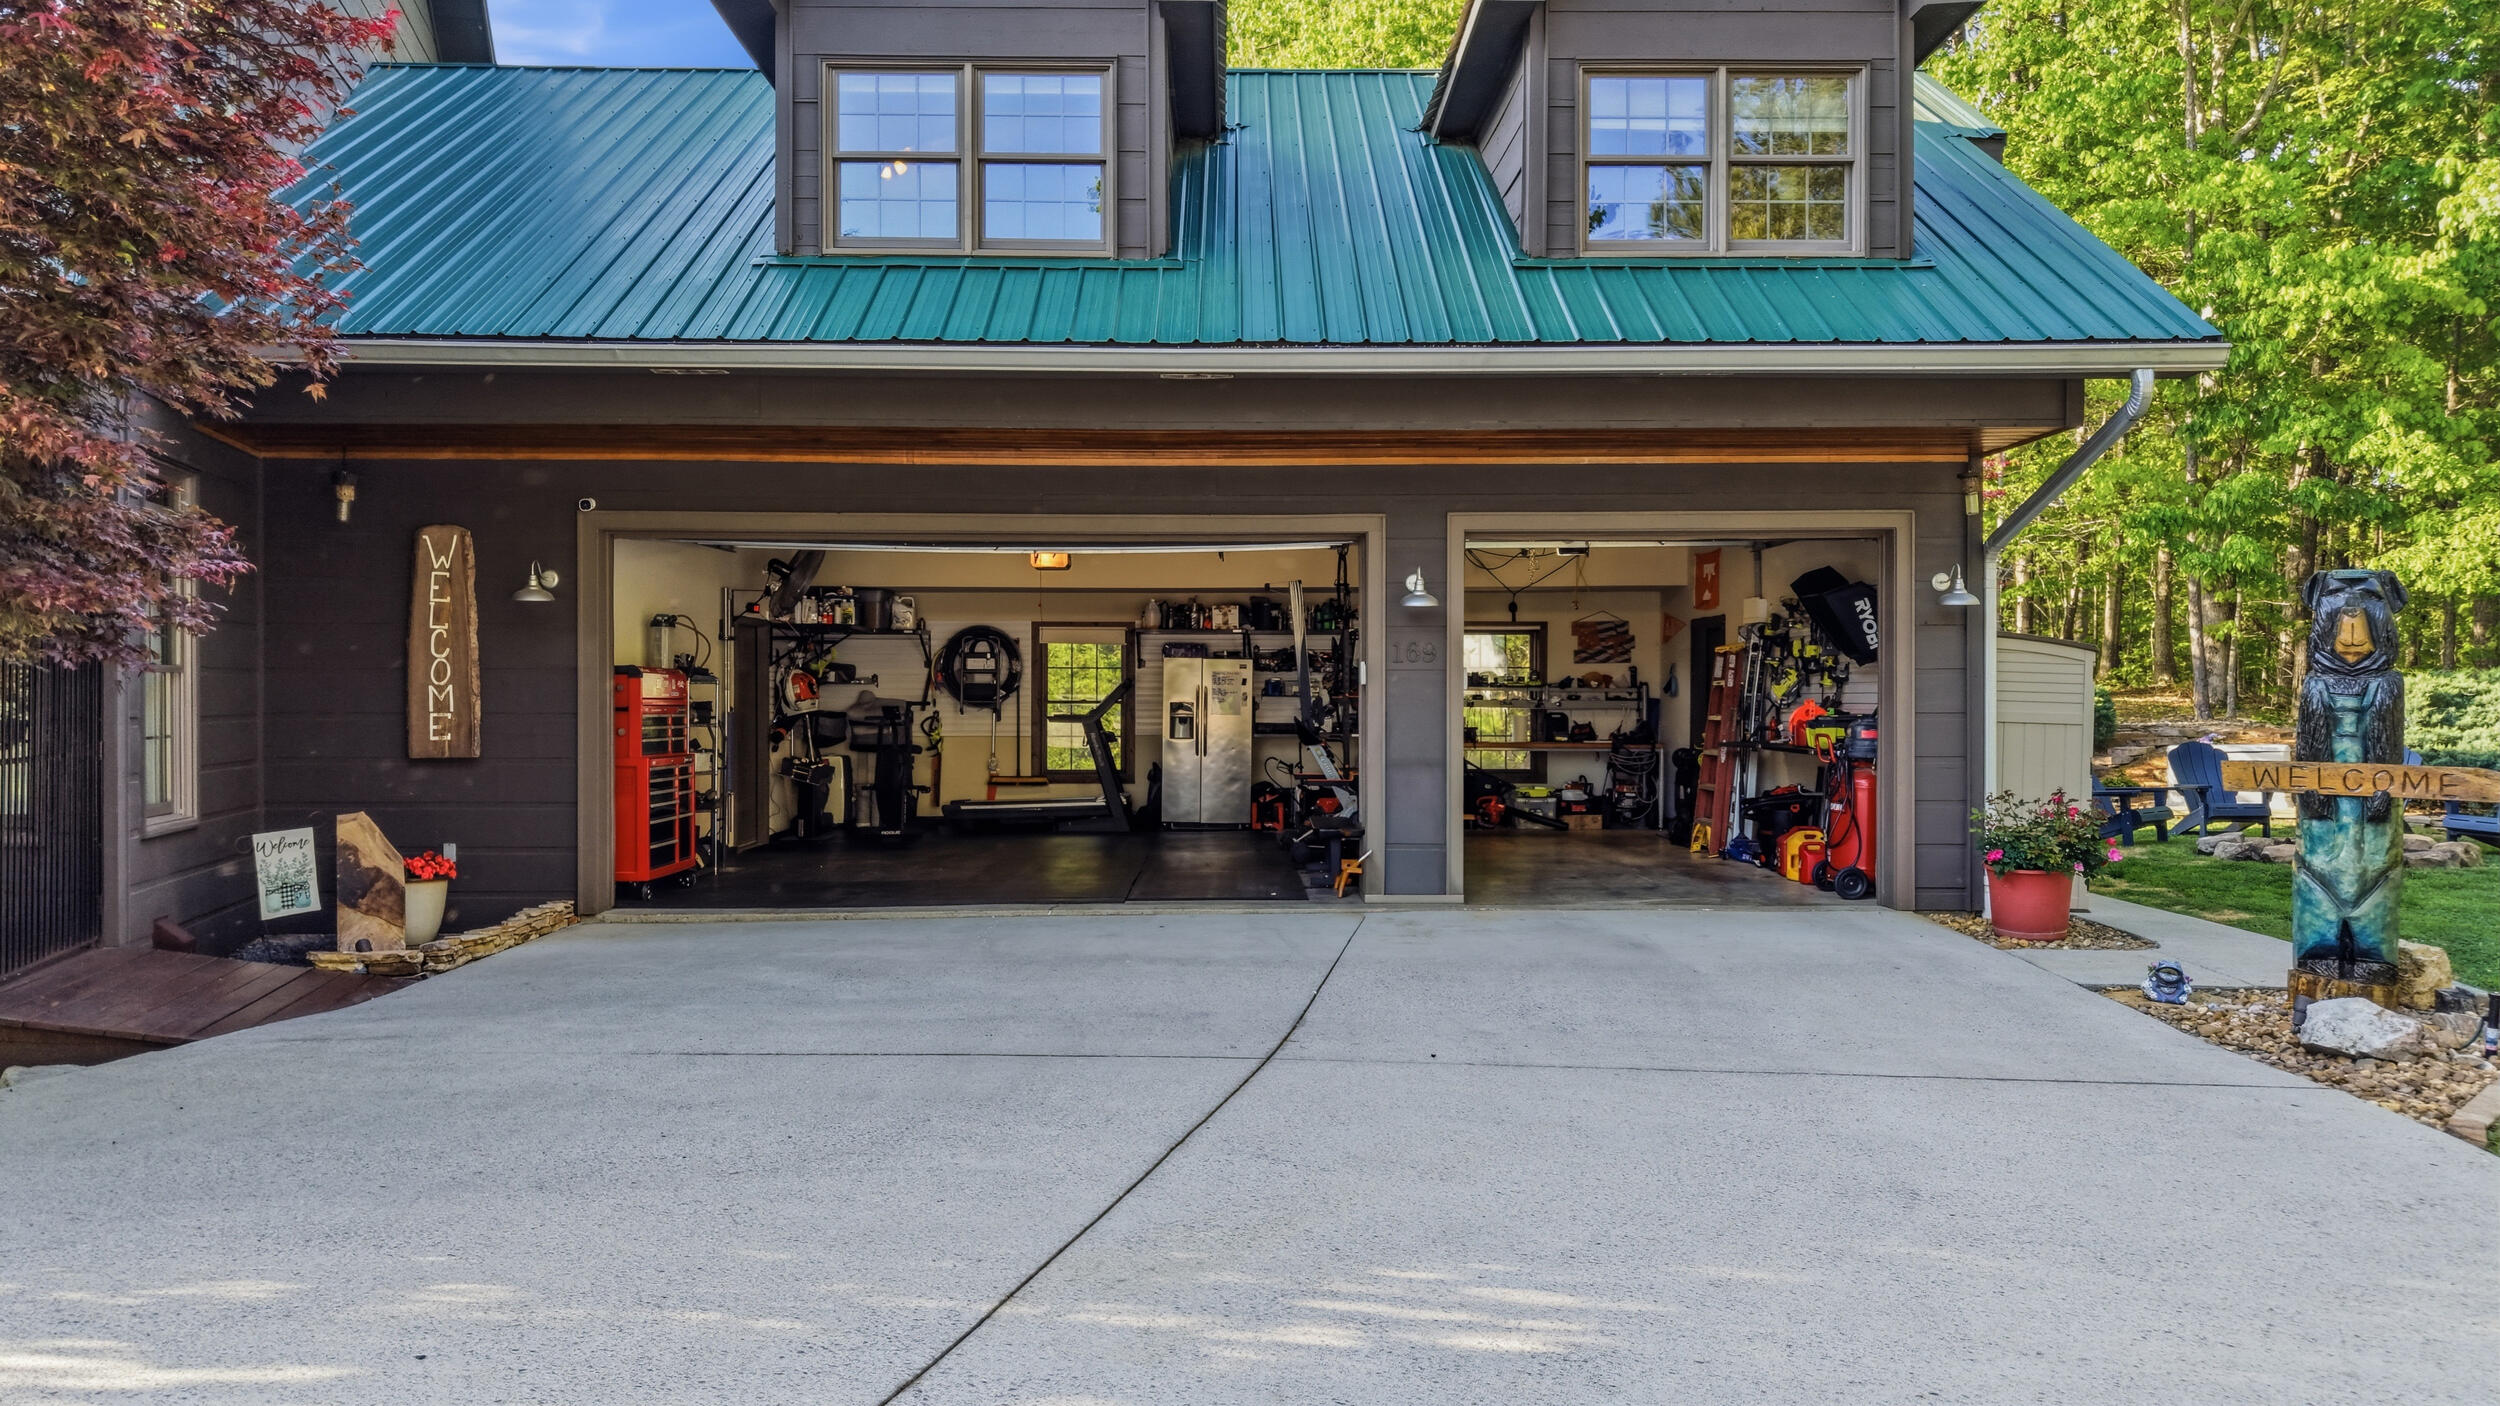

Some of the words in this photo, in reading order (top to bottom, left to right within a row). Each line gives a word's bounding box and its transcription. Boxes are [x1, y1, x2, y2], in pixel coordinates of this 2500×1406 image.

[422, 535, 458, 741] WELCOME
[1854, 597, 1879, 650] RYOBI
[2252, 765, 2460, 799] WELCOME
[256, 836, 310, 858] Welcome
